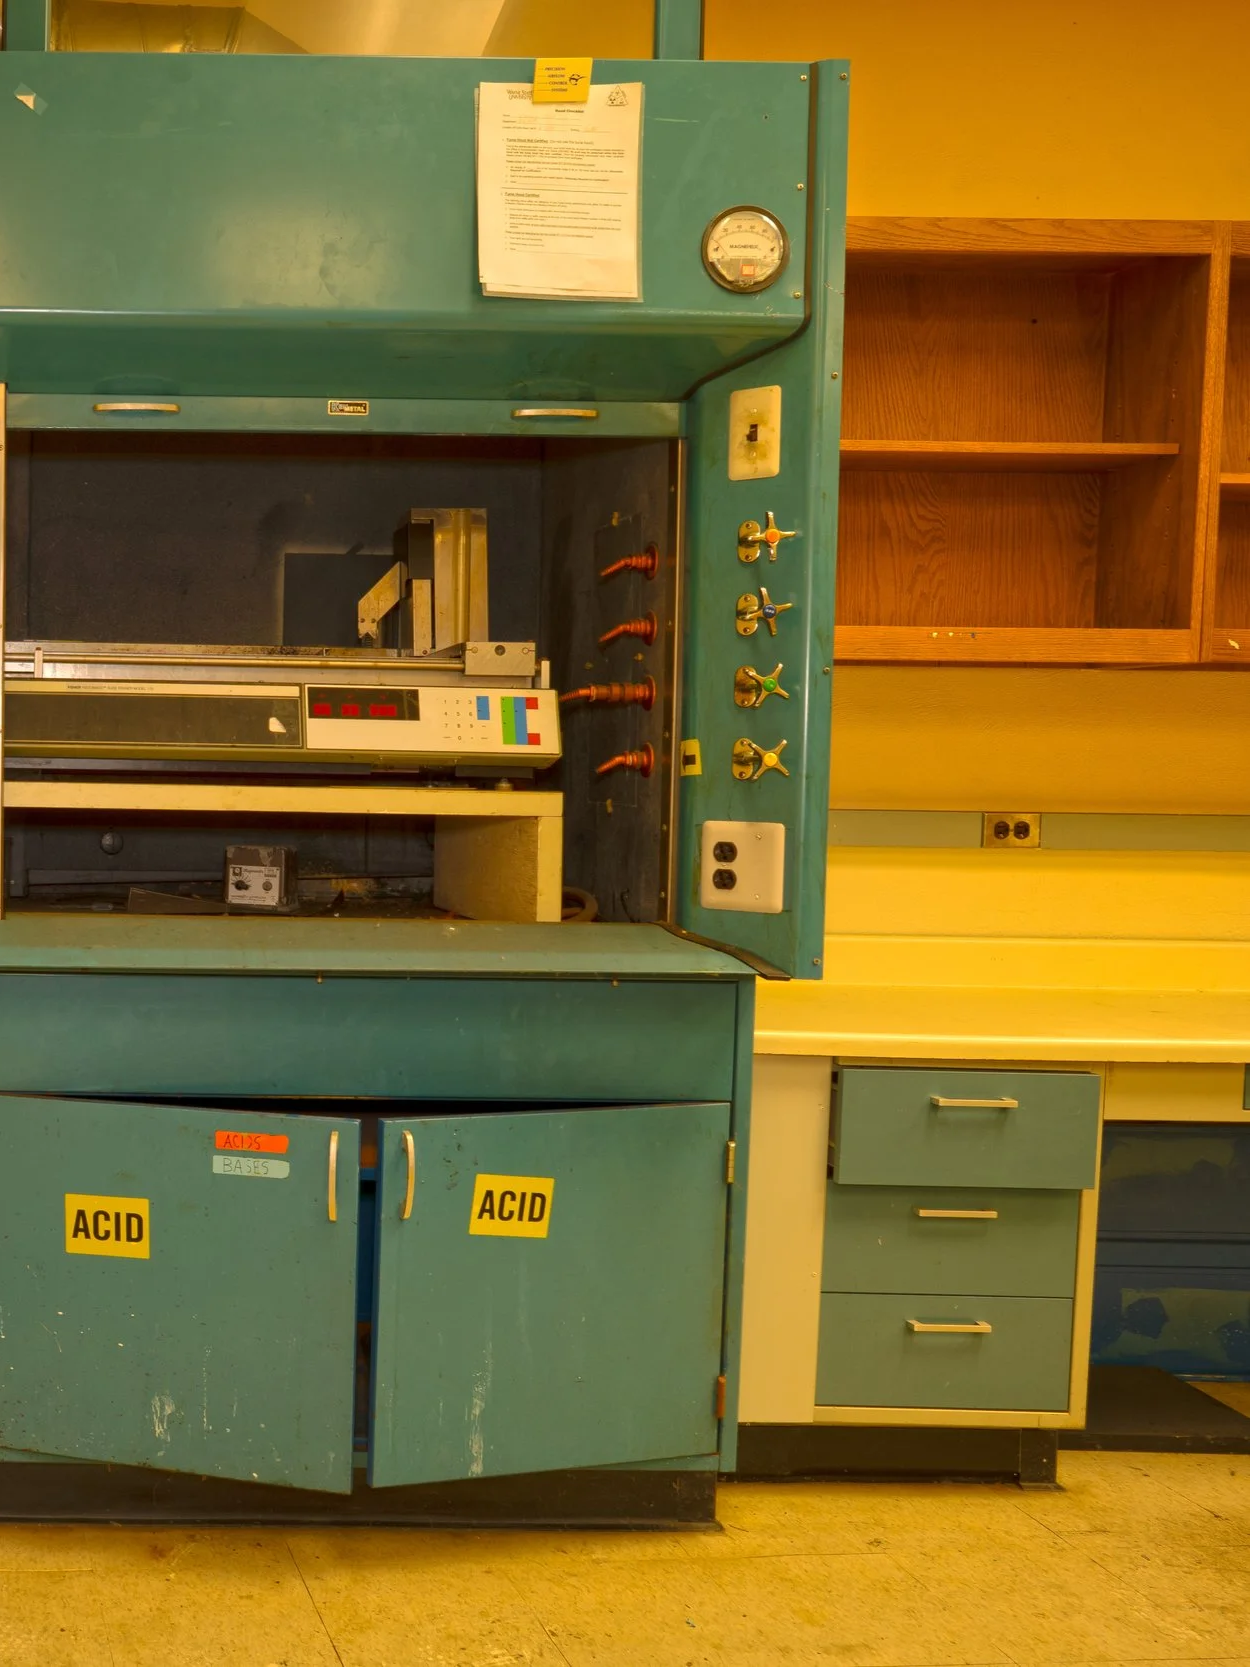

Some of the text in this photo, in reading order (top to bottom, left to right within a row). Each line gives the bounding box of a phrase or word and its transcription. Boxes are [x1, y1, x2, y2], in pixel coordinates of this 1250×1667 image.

[224, 1134, 261, 1150] ACIDS
[223, 1158, 269, 1174] BASES
[477, 1190, 546, 1222] ACID
[72, 1209, 144, 1243] ACID
